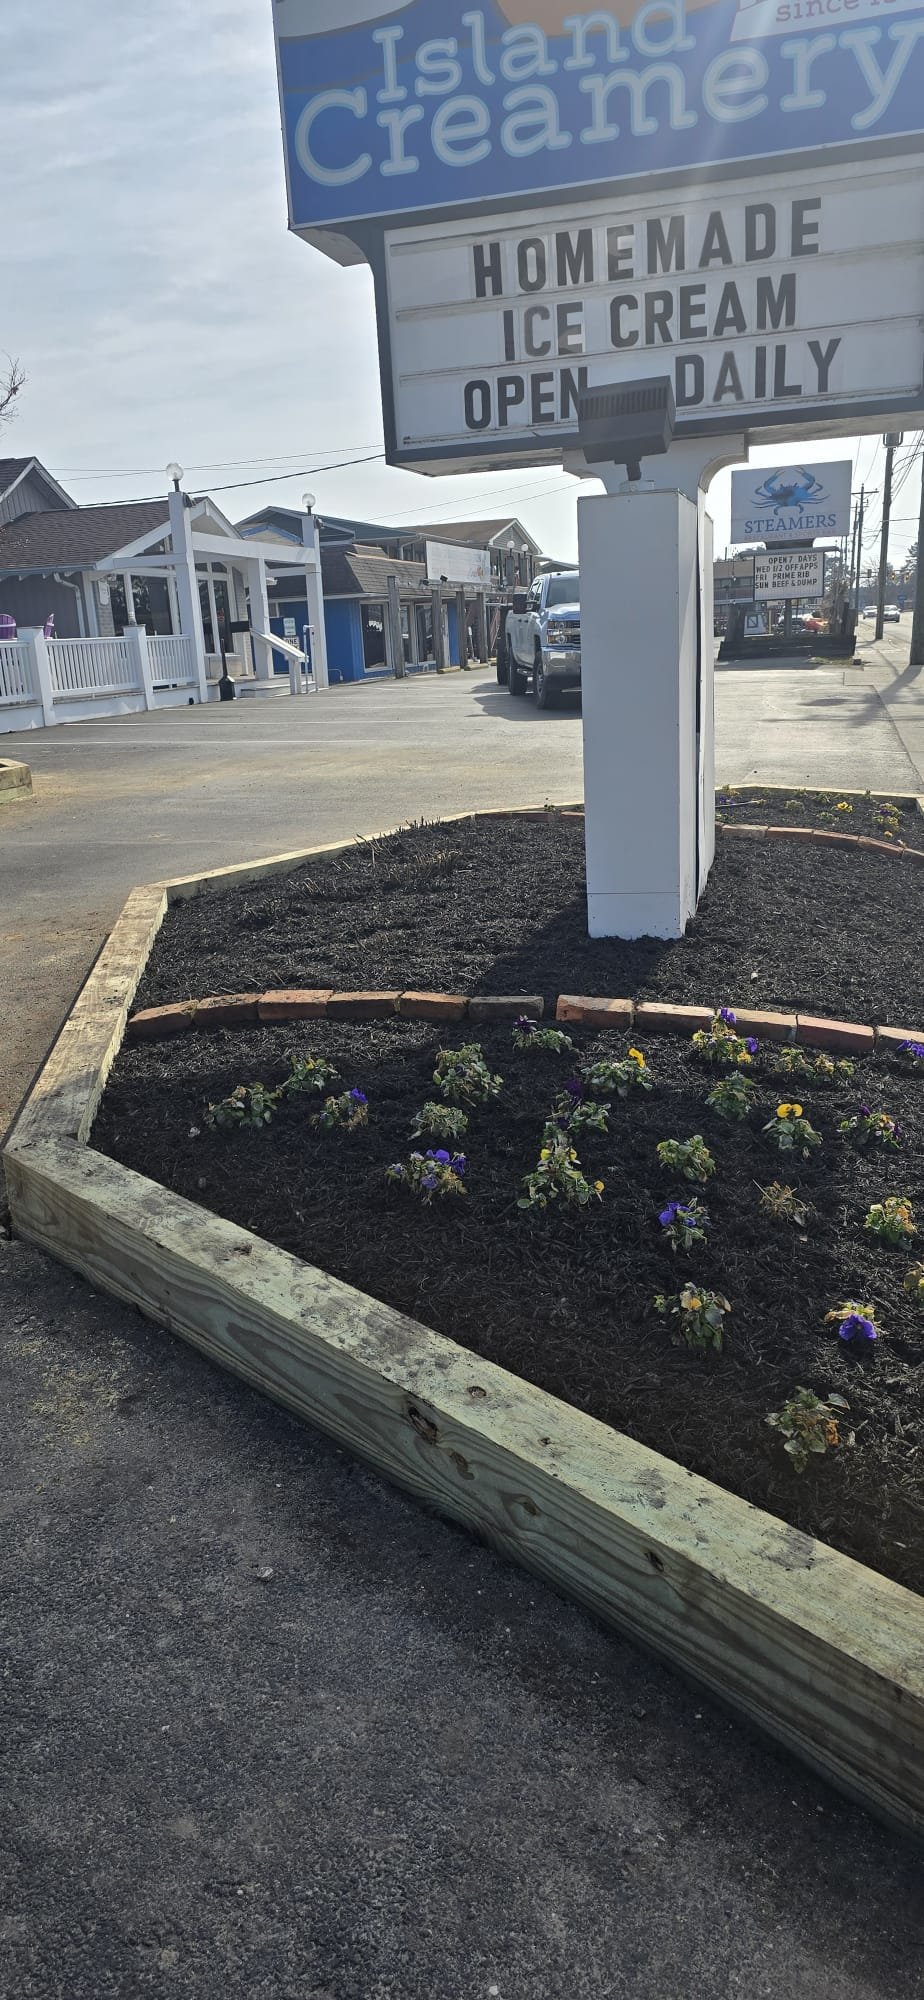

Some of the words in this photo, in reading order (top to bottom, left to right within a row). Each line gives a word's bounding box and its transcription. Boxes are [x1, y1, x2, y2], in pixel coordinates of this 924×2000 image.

[775, 0, 860, 22] since
[372, 0, 697, 104] Island
[295, 17, 924, 187] Creamery
[473, 197, 822, 298] HOMEMADE
[503, 301, 585, 361] ICE
[609, 273, 797, 349] CREAM
[464, 366, 589, 430] OPEN
[675, 337, 842, 407] DAILY
[744, 513, 837, 534] STEAMERS
[756, 565, 771, 573] WED
[773, 564, 783, 572] 1/2
[785, 563, 799, 571] OFF
[799, 561, 818, 570] APPS
[768, 556, 787, 564] OPEN
[798, 554, 817, 562] DAYS
[755, 573, 767, 581] FRI
[772, 572, 796, 580] PRIME
[755, 581, 769, 589] SUN
[772, 580, 789, 588] BEEF
[797, 578, 817, 586] DUMP
